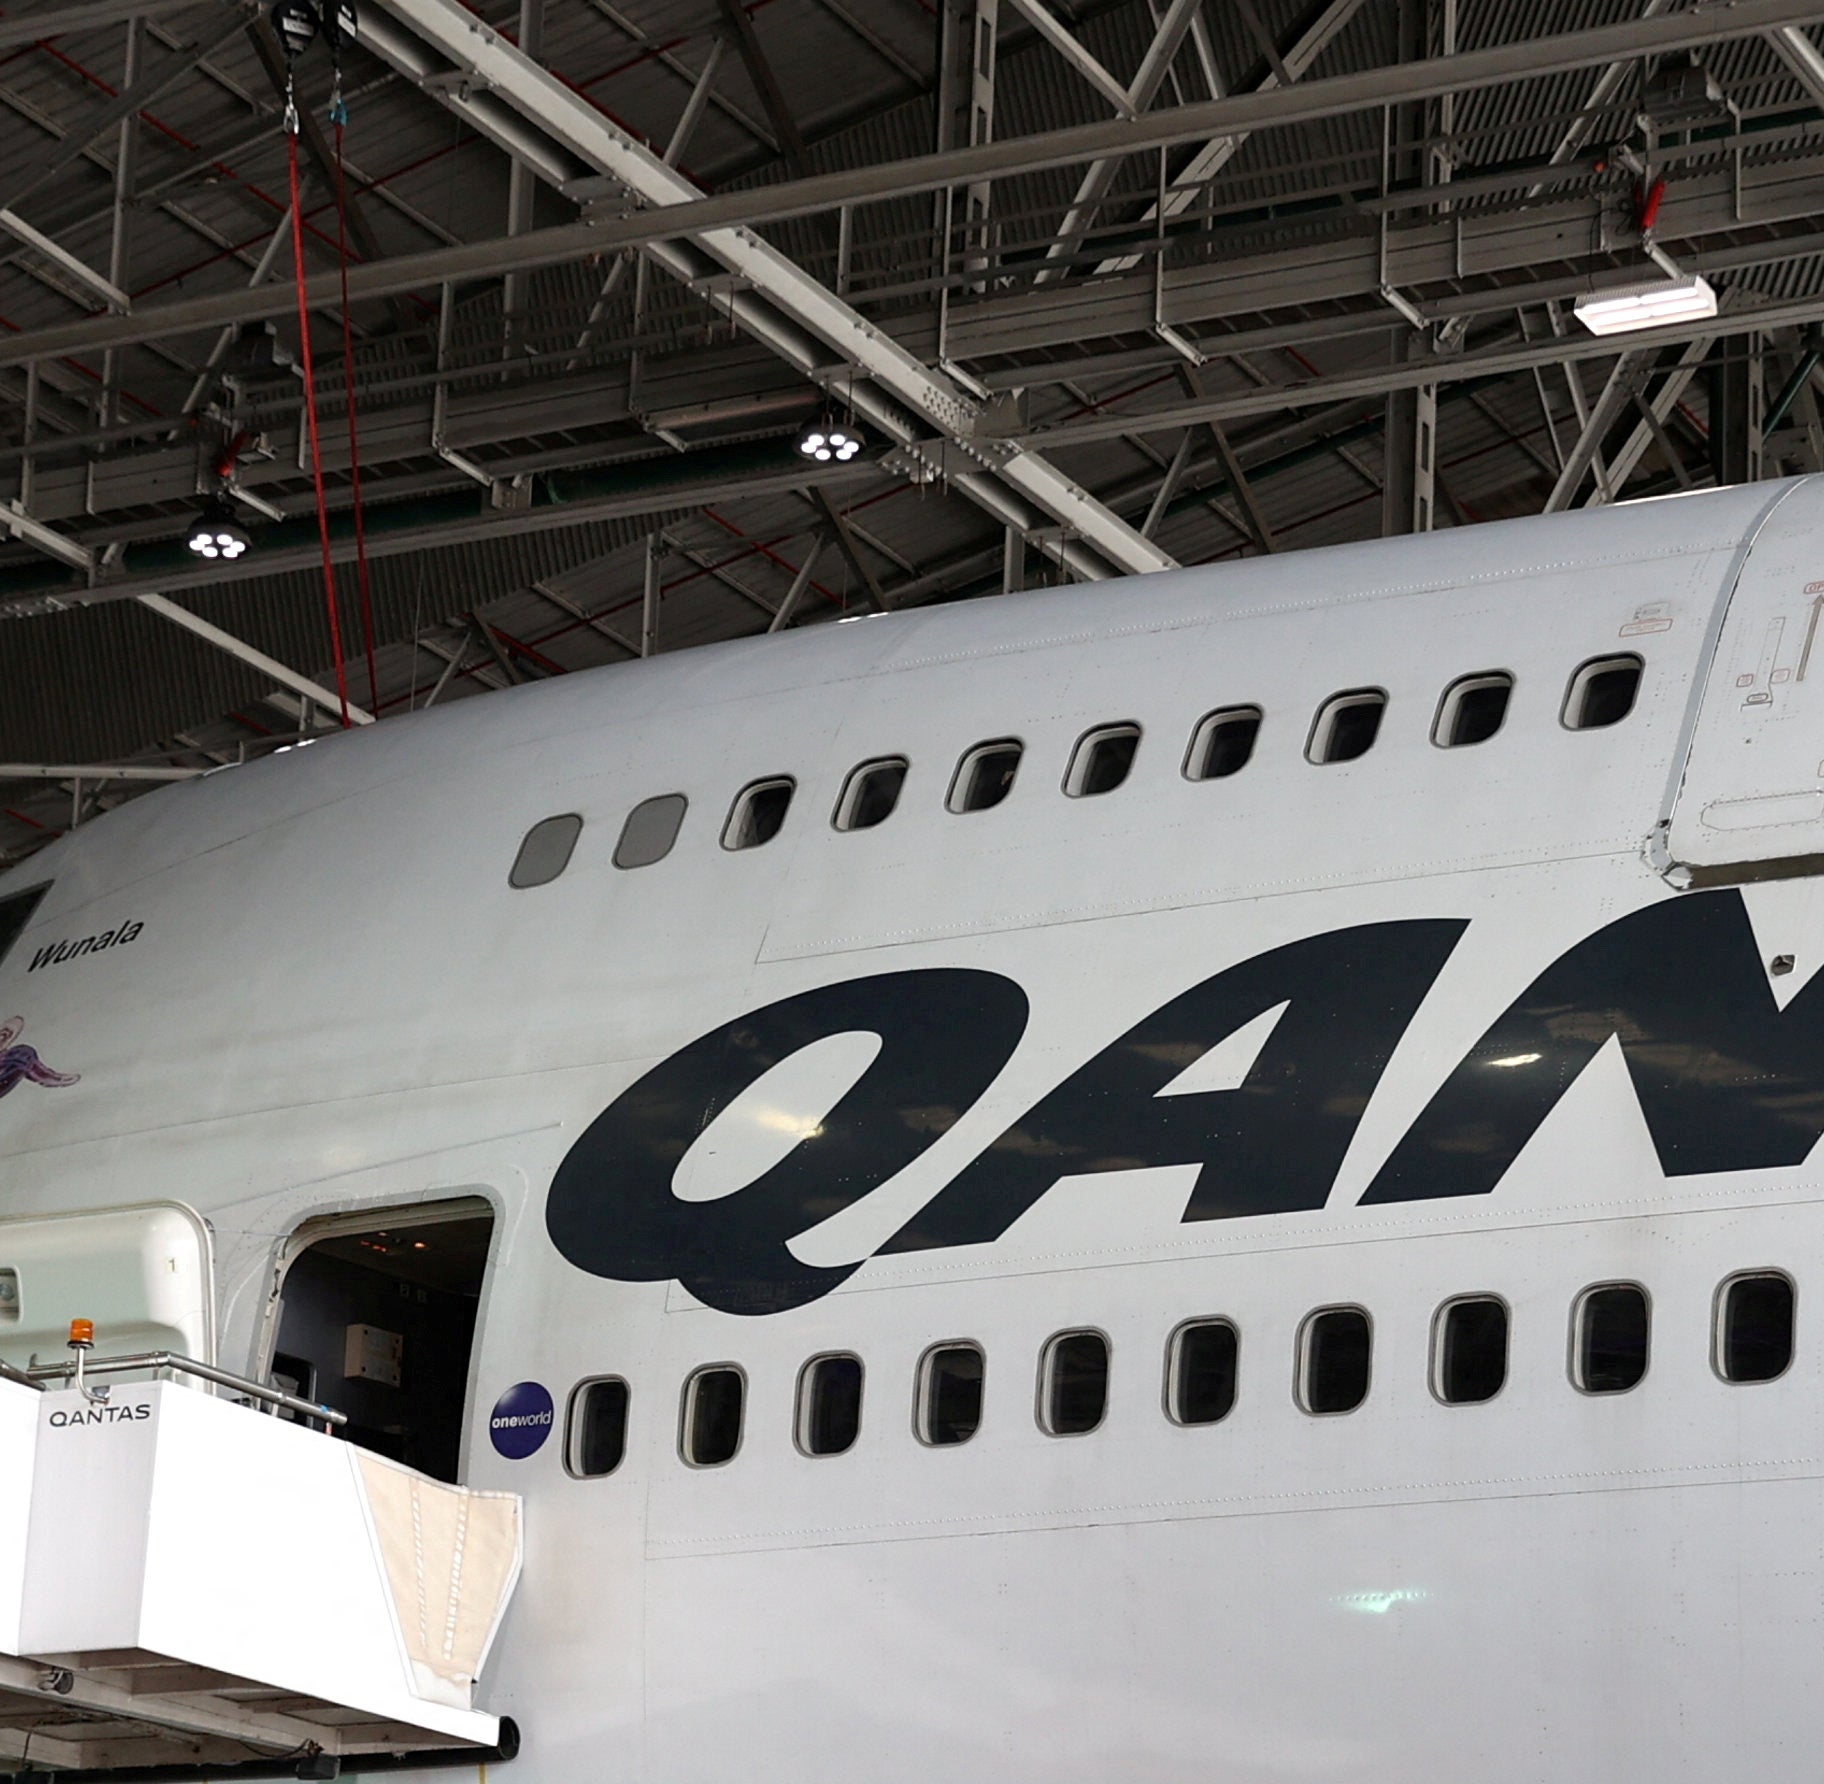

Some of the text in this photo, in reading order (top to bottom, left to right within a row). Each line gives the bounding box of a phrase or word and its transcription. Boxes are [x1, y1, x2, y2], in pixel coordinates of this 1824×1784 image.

[27, 919, 145, 973] Wunala
[48, 1403, 151, 1428] QANTAS
[491, 1409, 553, 1430] oneworld
